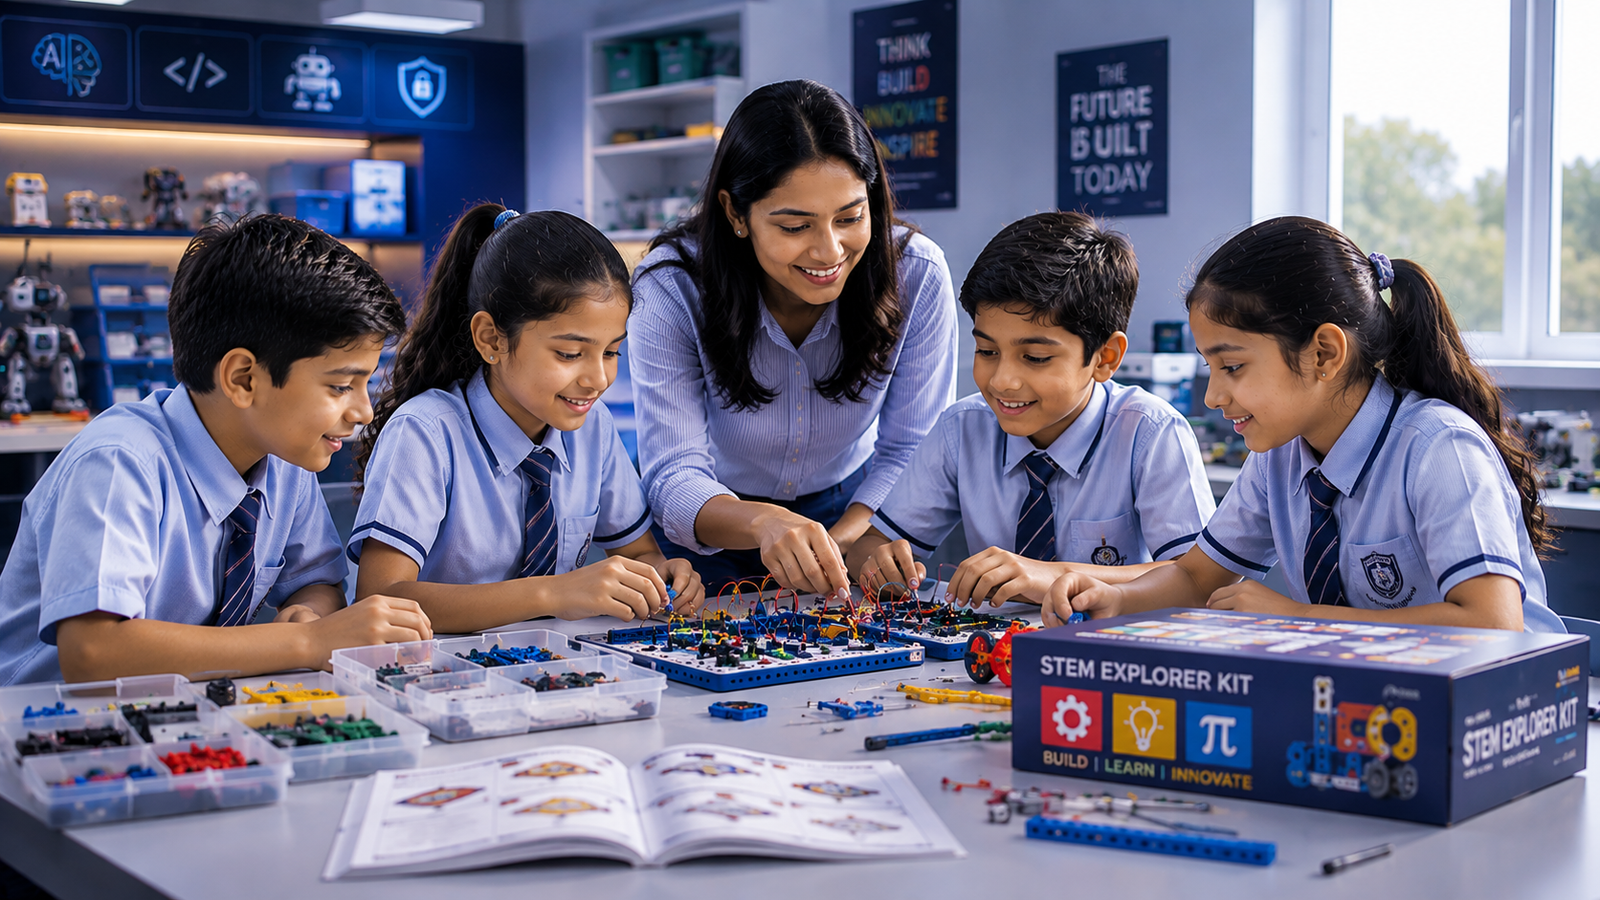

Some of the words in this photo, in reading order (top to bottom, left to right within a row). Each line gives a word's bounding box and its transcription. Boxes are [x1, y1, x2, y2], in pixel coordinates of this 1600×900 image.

[876, 32, 932, 64] THINK
[877, 65, 931, 97] BUILD
[1096, 62, 1128, 86] THE
[1070, 85, 1153, 123] FUTURE
[1070, 160, 1154, 195] TODAY
[1040, 655, 1095, 679] STEM
[1101, 661, 1212, 692] EXPLORER
[1217, 672, 1253, 695] KIT
[1462, 722, 1501, 767] STEM
[1502, 704, 1558, 752] EXPLORER
[1559, 696, 1579, 731] KIT
[1043, 750, 1089, 769] BUILD
[1105, 758, 1155, 777] LEARN
[1171, 767, 1253, 791] INNOVATE
